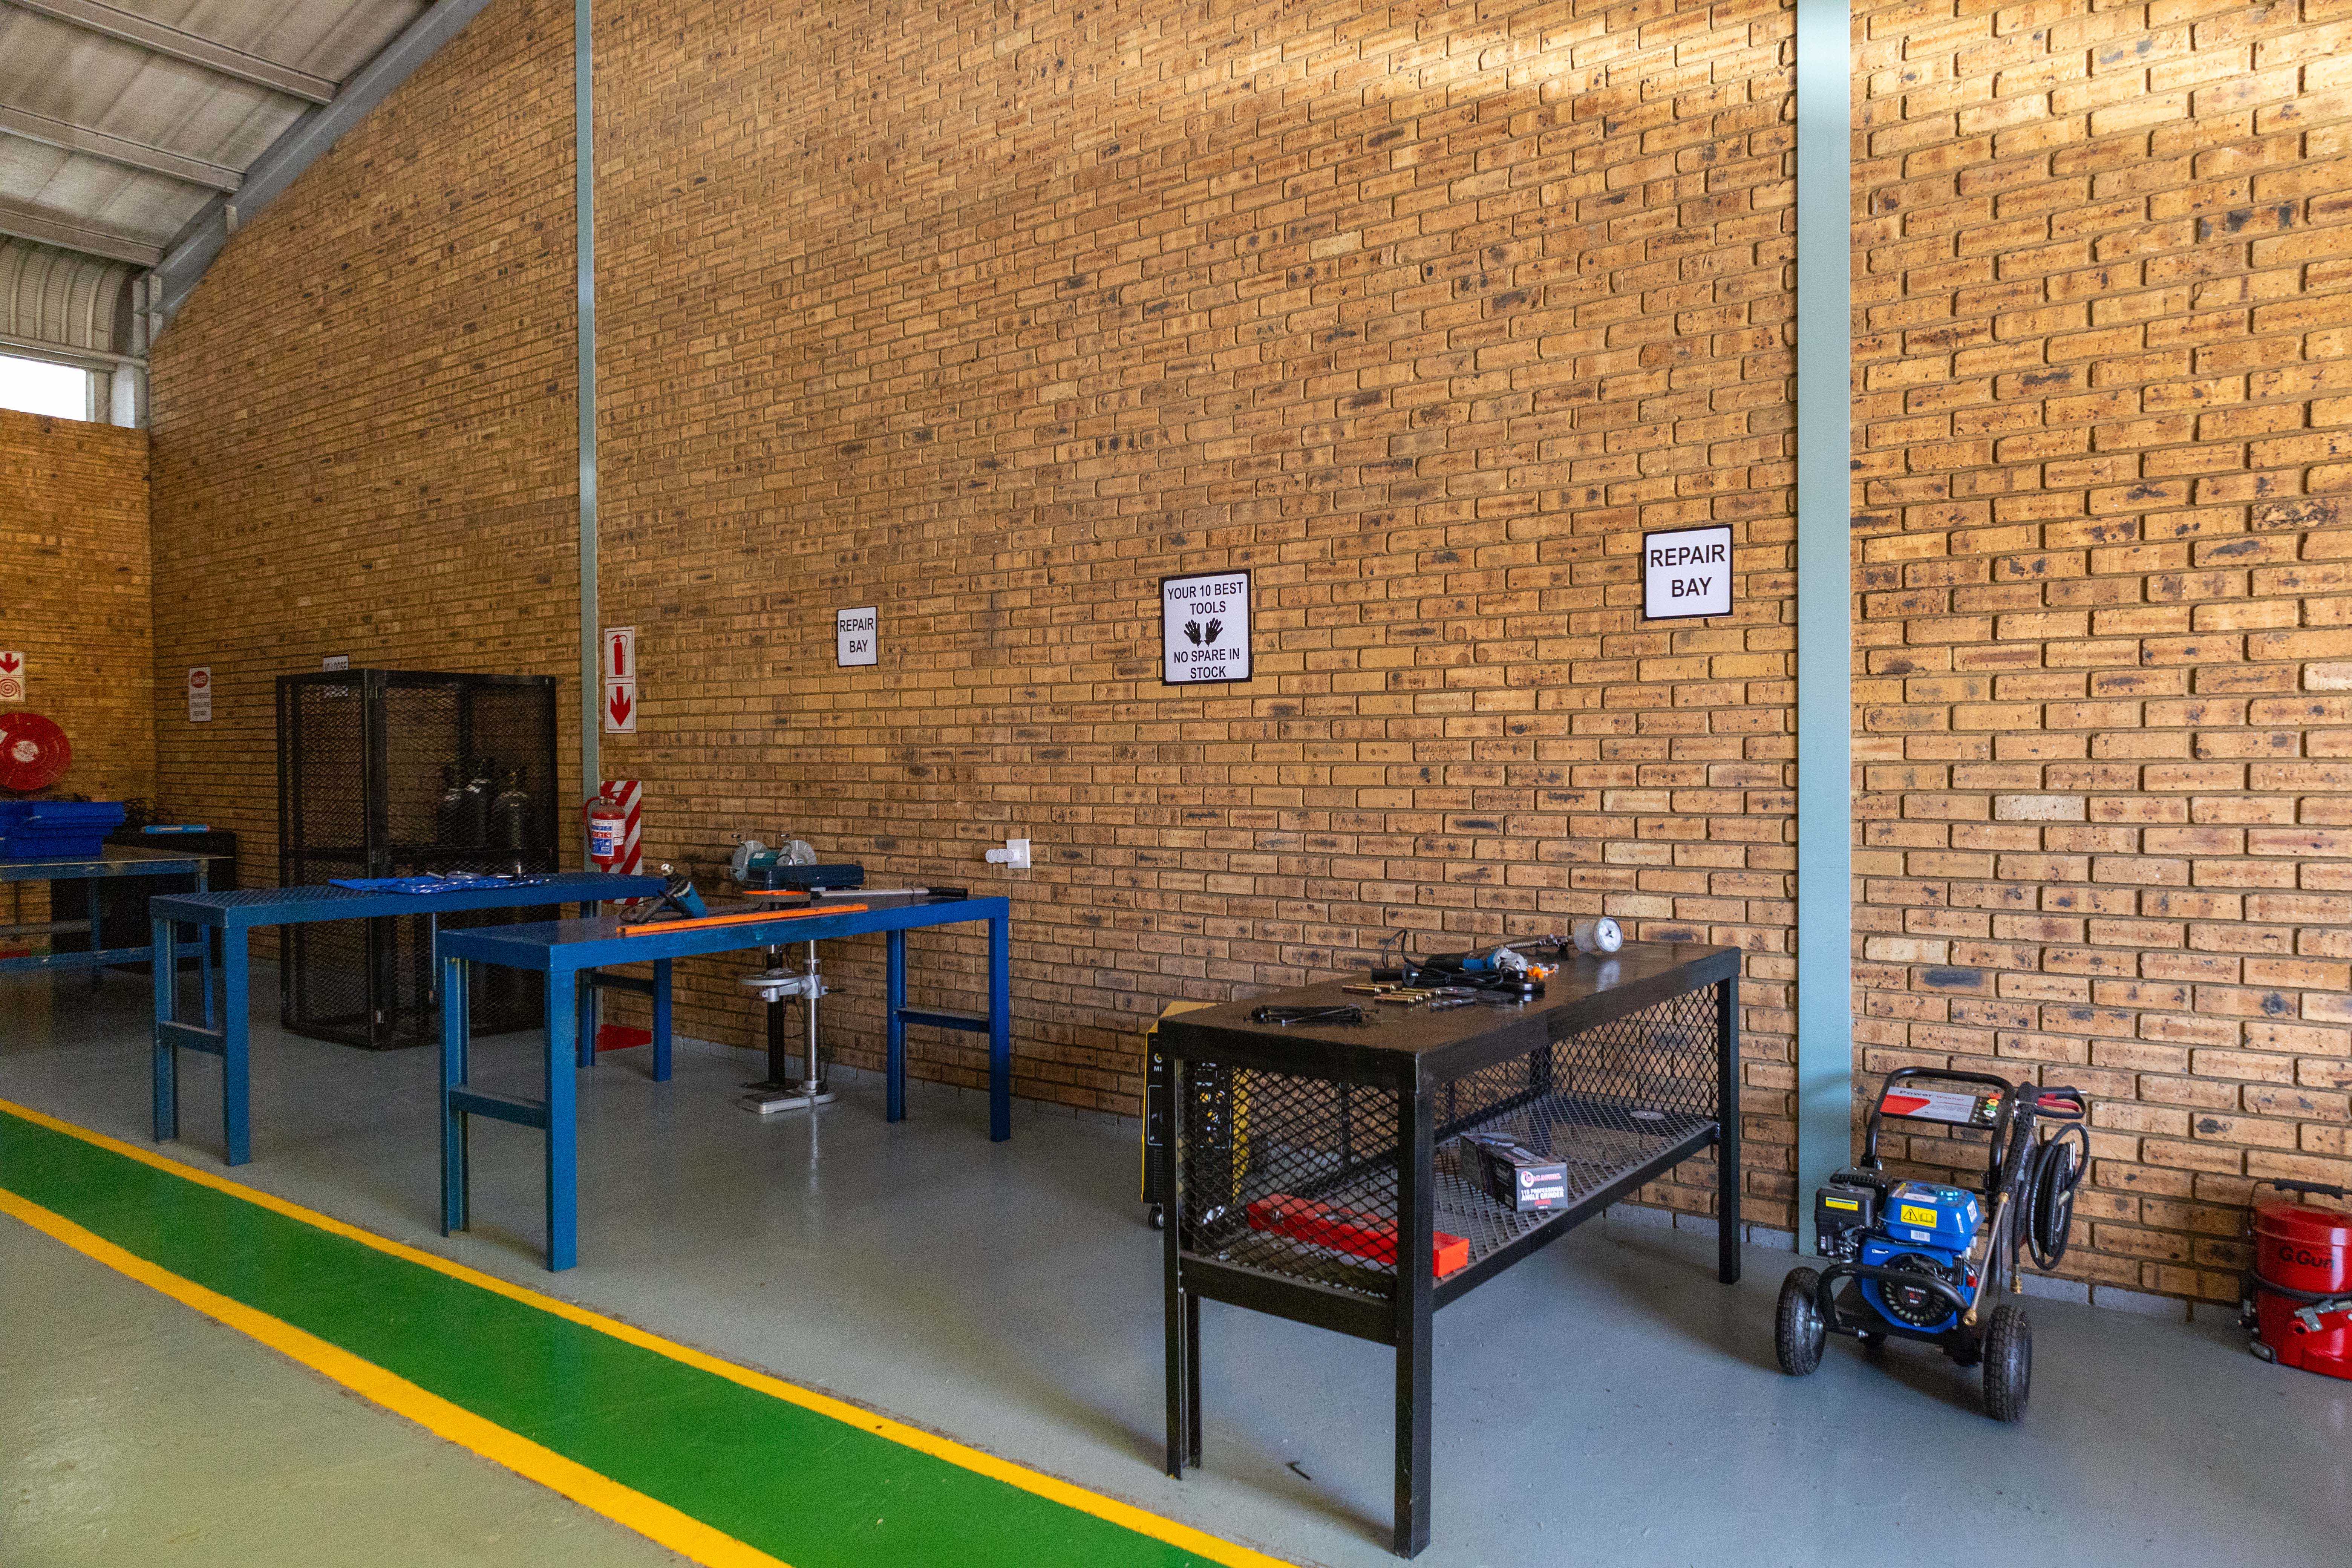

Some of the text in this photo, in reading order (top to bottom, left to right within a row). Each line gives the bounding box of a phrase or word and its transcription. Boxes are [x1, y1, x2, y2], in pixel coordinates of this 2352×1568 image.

[1650, 544, 1726, 568] REPAIR
[1167, 582, 1244, 600] YOUR 10 BEST
[1671, 577, 1712, 598] BAY
[1190, 600, 1226, 615] TOOLS
[840, 617, 874, 632] REPAIR
[850, 639, 868, 652] BAY
[1174, 648, 1240, 663] NO SPARE IN
[1190, 665, 1227, 679] STOCK
[1540, 1191, 1564, 1199] GRINDER
